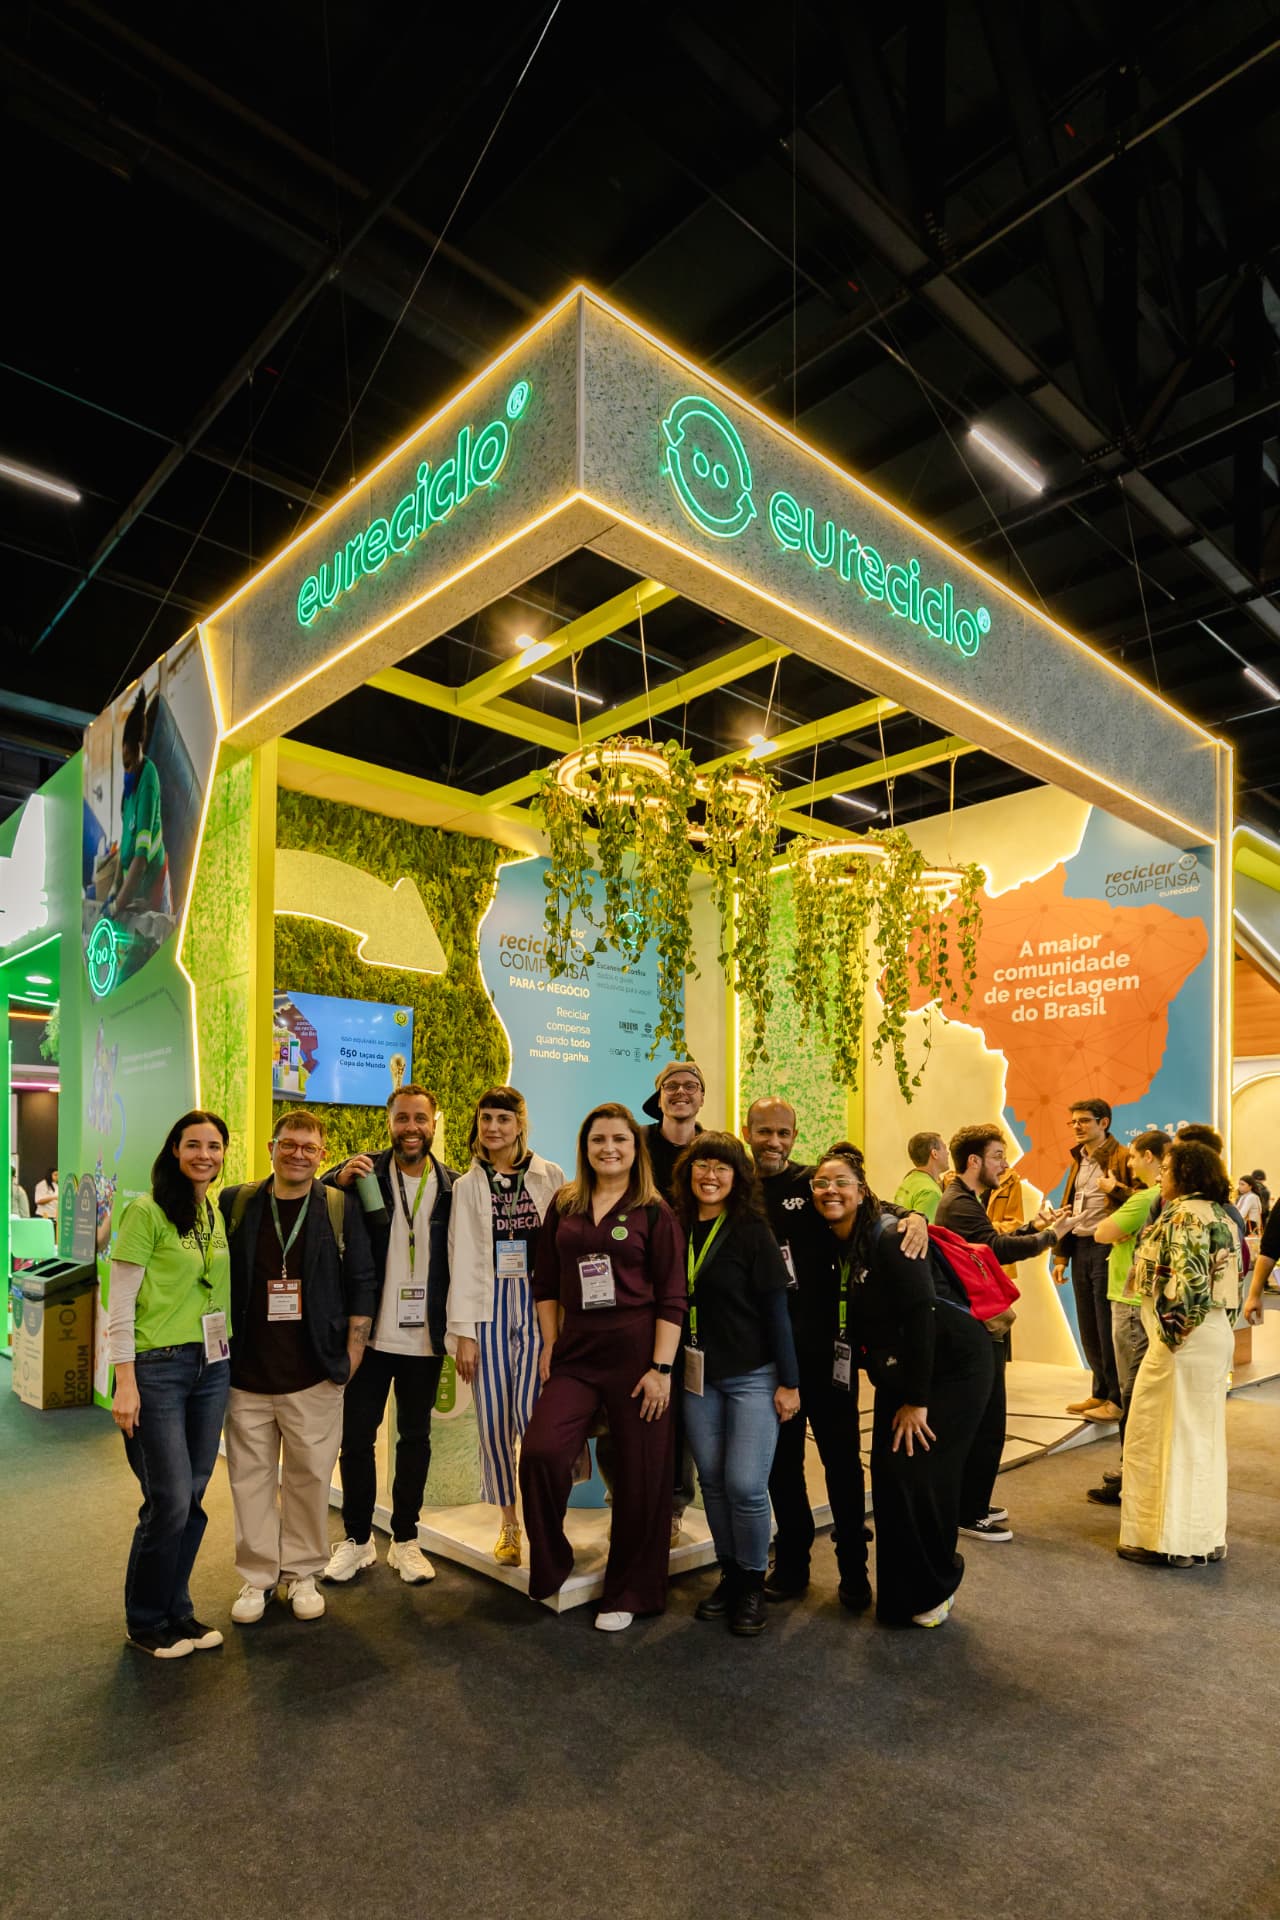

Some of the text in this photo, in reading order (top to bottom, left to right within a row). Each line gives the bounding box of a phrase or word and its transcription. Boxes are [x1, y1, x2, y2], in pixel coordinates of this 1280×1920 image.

[1105, 861, 1175, 885] reciclar
[1105, 871, 1201, 899] COMPENSA
[1018, 932, 1102, 958] A maior
[993, 951, 1131, 982] comunidade
[509, 975, 536, 990] PARA
[546, 980, 590, 998] NEGÓCIO
[983, 975, 1140, 1004] de reciclagem
[556, 1006, 590, 1021] Reciclar
[1011, 996, 1106, 1023] do Brasil
[546, 1020, 591, 1035] compensa
[340, 1047, 357, 1058] 650
[529, 1047, 561, 1061] mundo
[536, 1035, 591, 1049] quando todo
[77, 1343, 90, 1403] COMUM
[63, 1369, 77, 1404] LIXO
